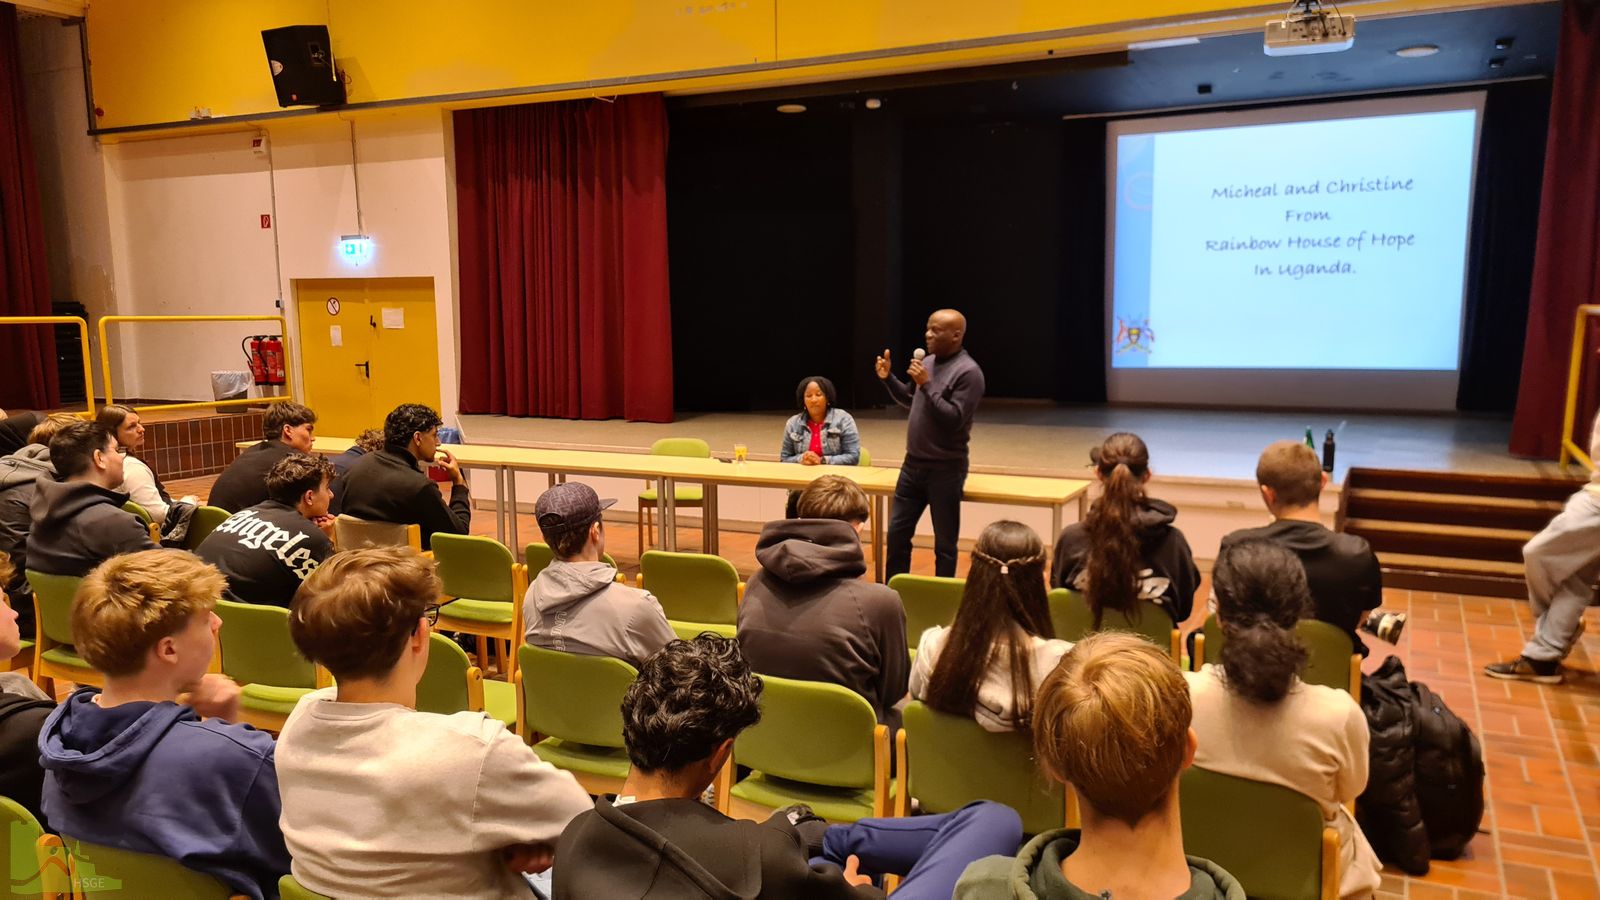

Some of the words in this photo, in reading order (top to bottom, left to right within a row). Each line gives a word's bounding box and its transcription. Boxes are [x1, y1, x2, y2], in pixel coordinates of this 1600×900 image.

[1211, 183, 1278, 199] Micheal
[1284, 181, 1320, 196] and
[1326, 176, 1415, 194] Christine
[1284, 209, 1331, 222] From
[1205, 237, 1282, 251] Rainbow
[1287, 235, 1341, 250] House
[1346, 230, 1367, 251] of
[1371, 233, 1415, 251] Hope
[1254, 264, 1273, 276] In
[1278, 260, 1357, 280] Uganda.
